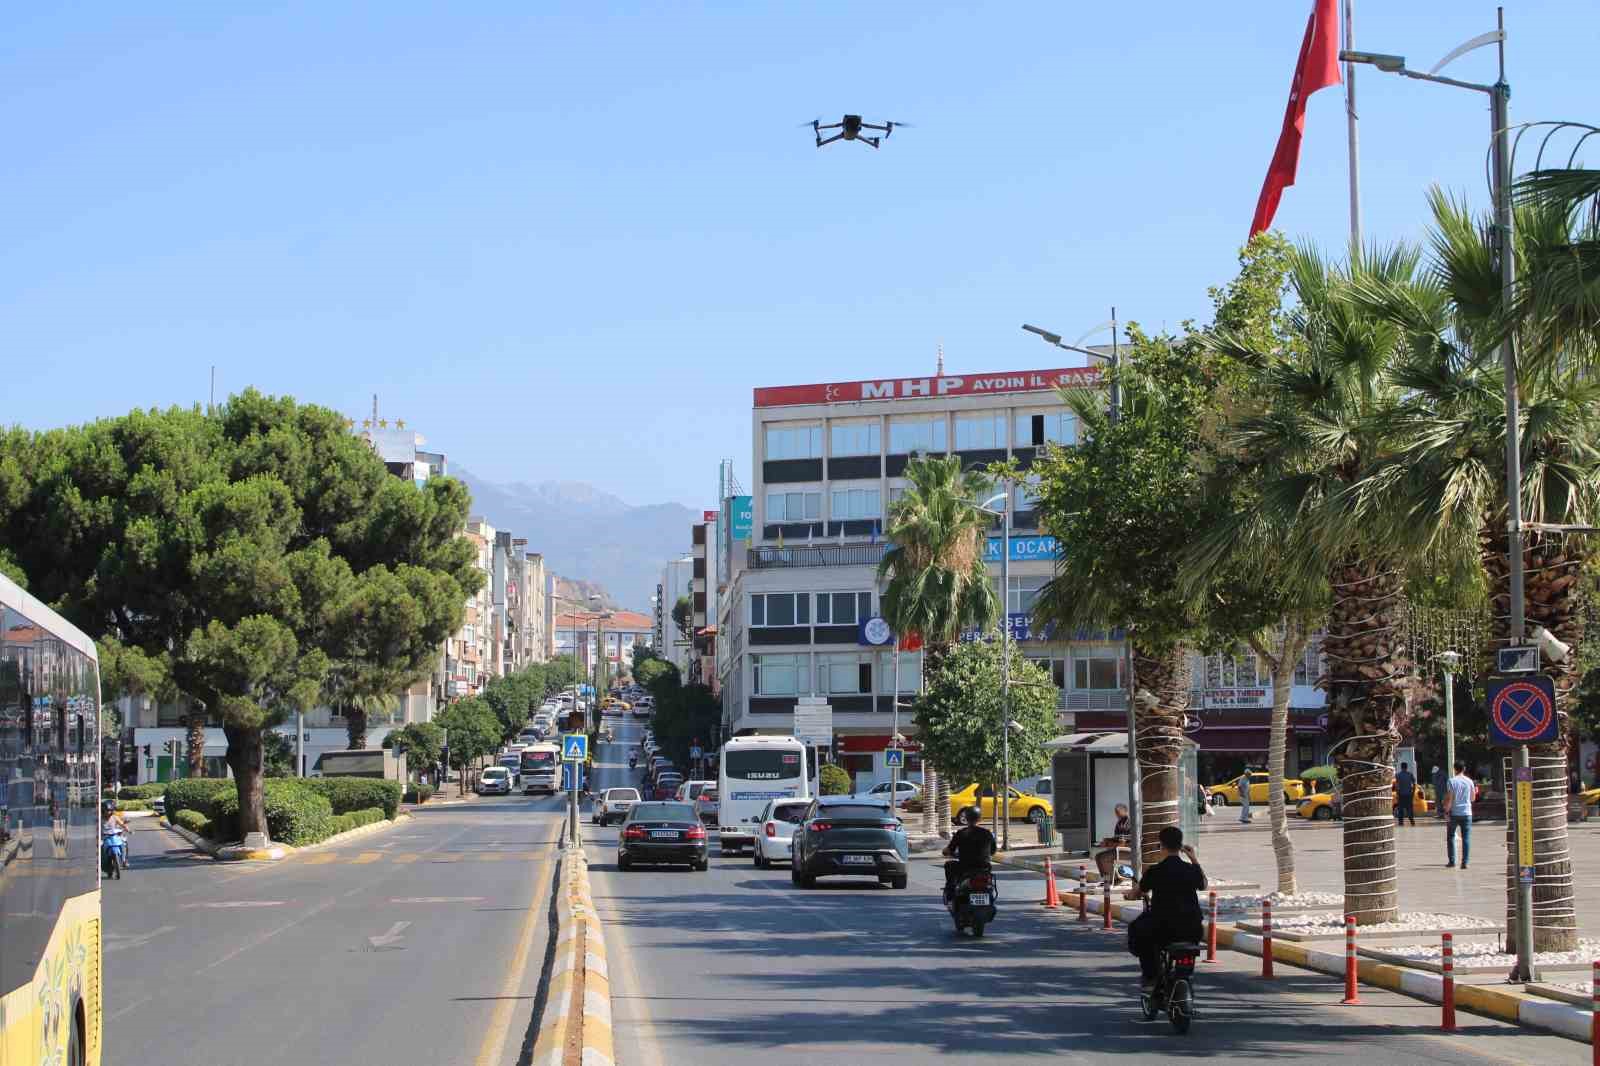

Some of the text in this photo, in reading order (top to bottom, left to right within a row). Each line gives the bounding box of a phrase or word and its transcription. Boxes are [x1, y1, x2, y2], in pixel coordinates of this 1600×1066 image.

[862, 378, 963, 398] MHP
[973, 376, 1025, 390] AYDIN
[1031, 374, 1047, 387] İL
